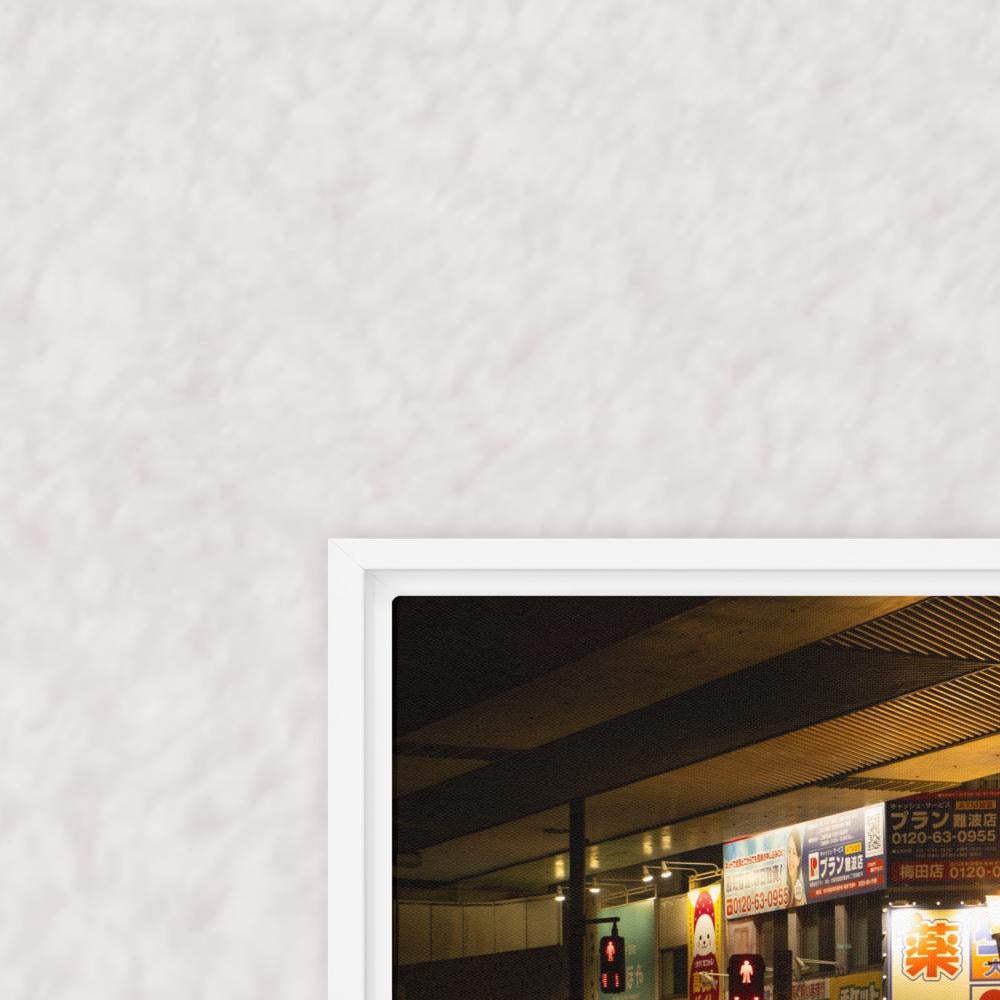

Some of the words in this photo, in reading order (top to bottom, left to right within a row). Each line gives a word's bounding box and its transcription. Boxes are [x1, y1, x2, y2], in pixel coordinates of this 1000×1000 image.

[890, 810, 950, 831] プラン
[891, 830, 996, 844] 0120-63-0955
[820, 855, 845, 879] プラン
[900, 864, 945, 879] 梅田店
[733, 886, 791, 915] 0120-63-0955
[904, 914, 960, 977] 薬
